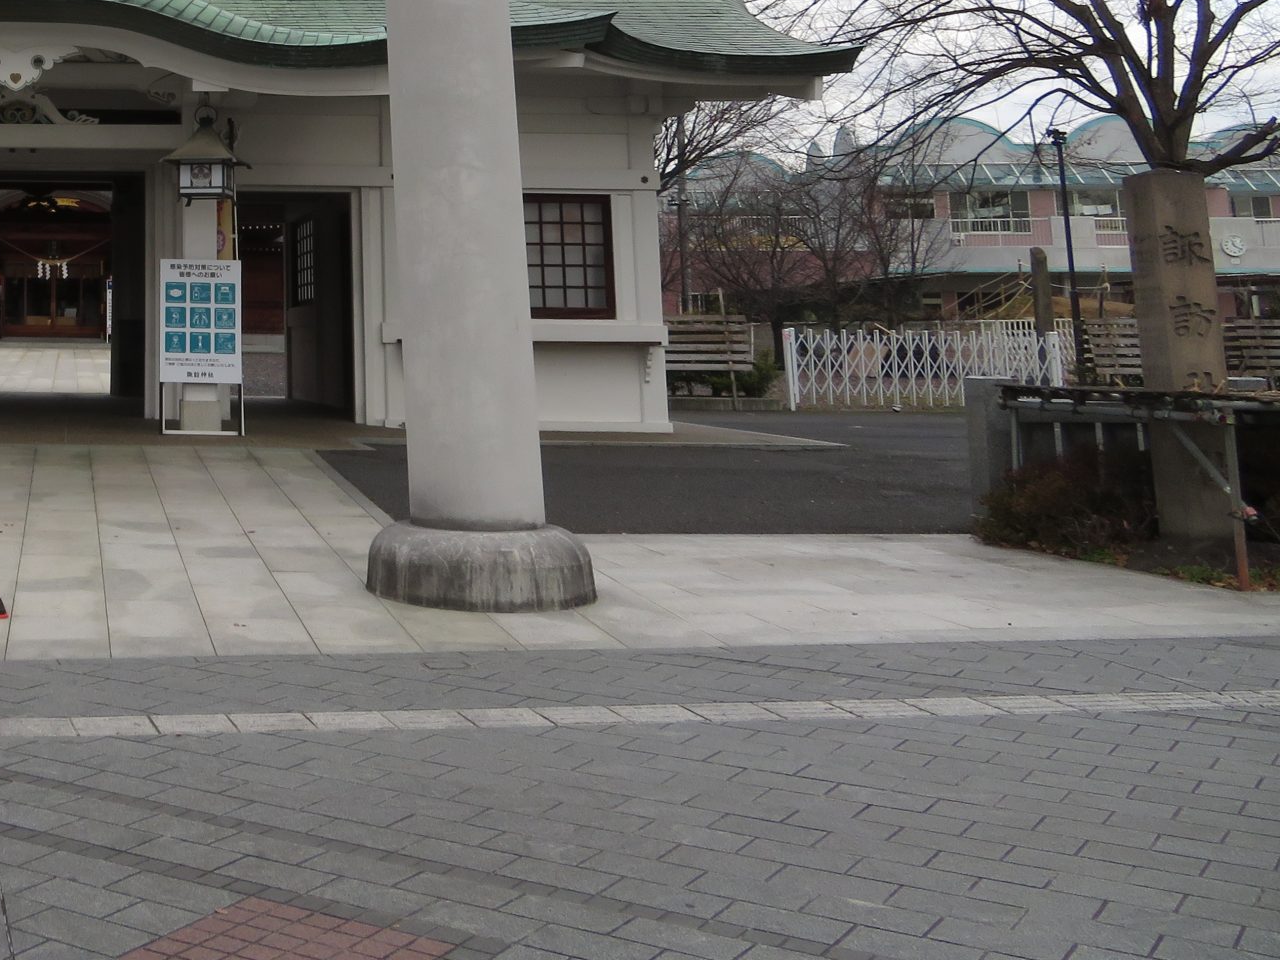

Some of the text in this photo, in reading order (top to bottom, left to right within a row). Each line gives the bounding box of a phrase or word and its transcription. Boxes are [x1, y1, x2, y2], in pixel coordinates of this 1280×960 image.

[169, 263, 231, 271] 感染予防対策について
